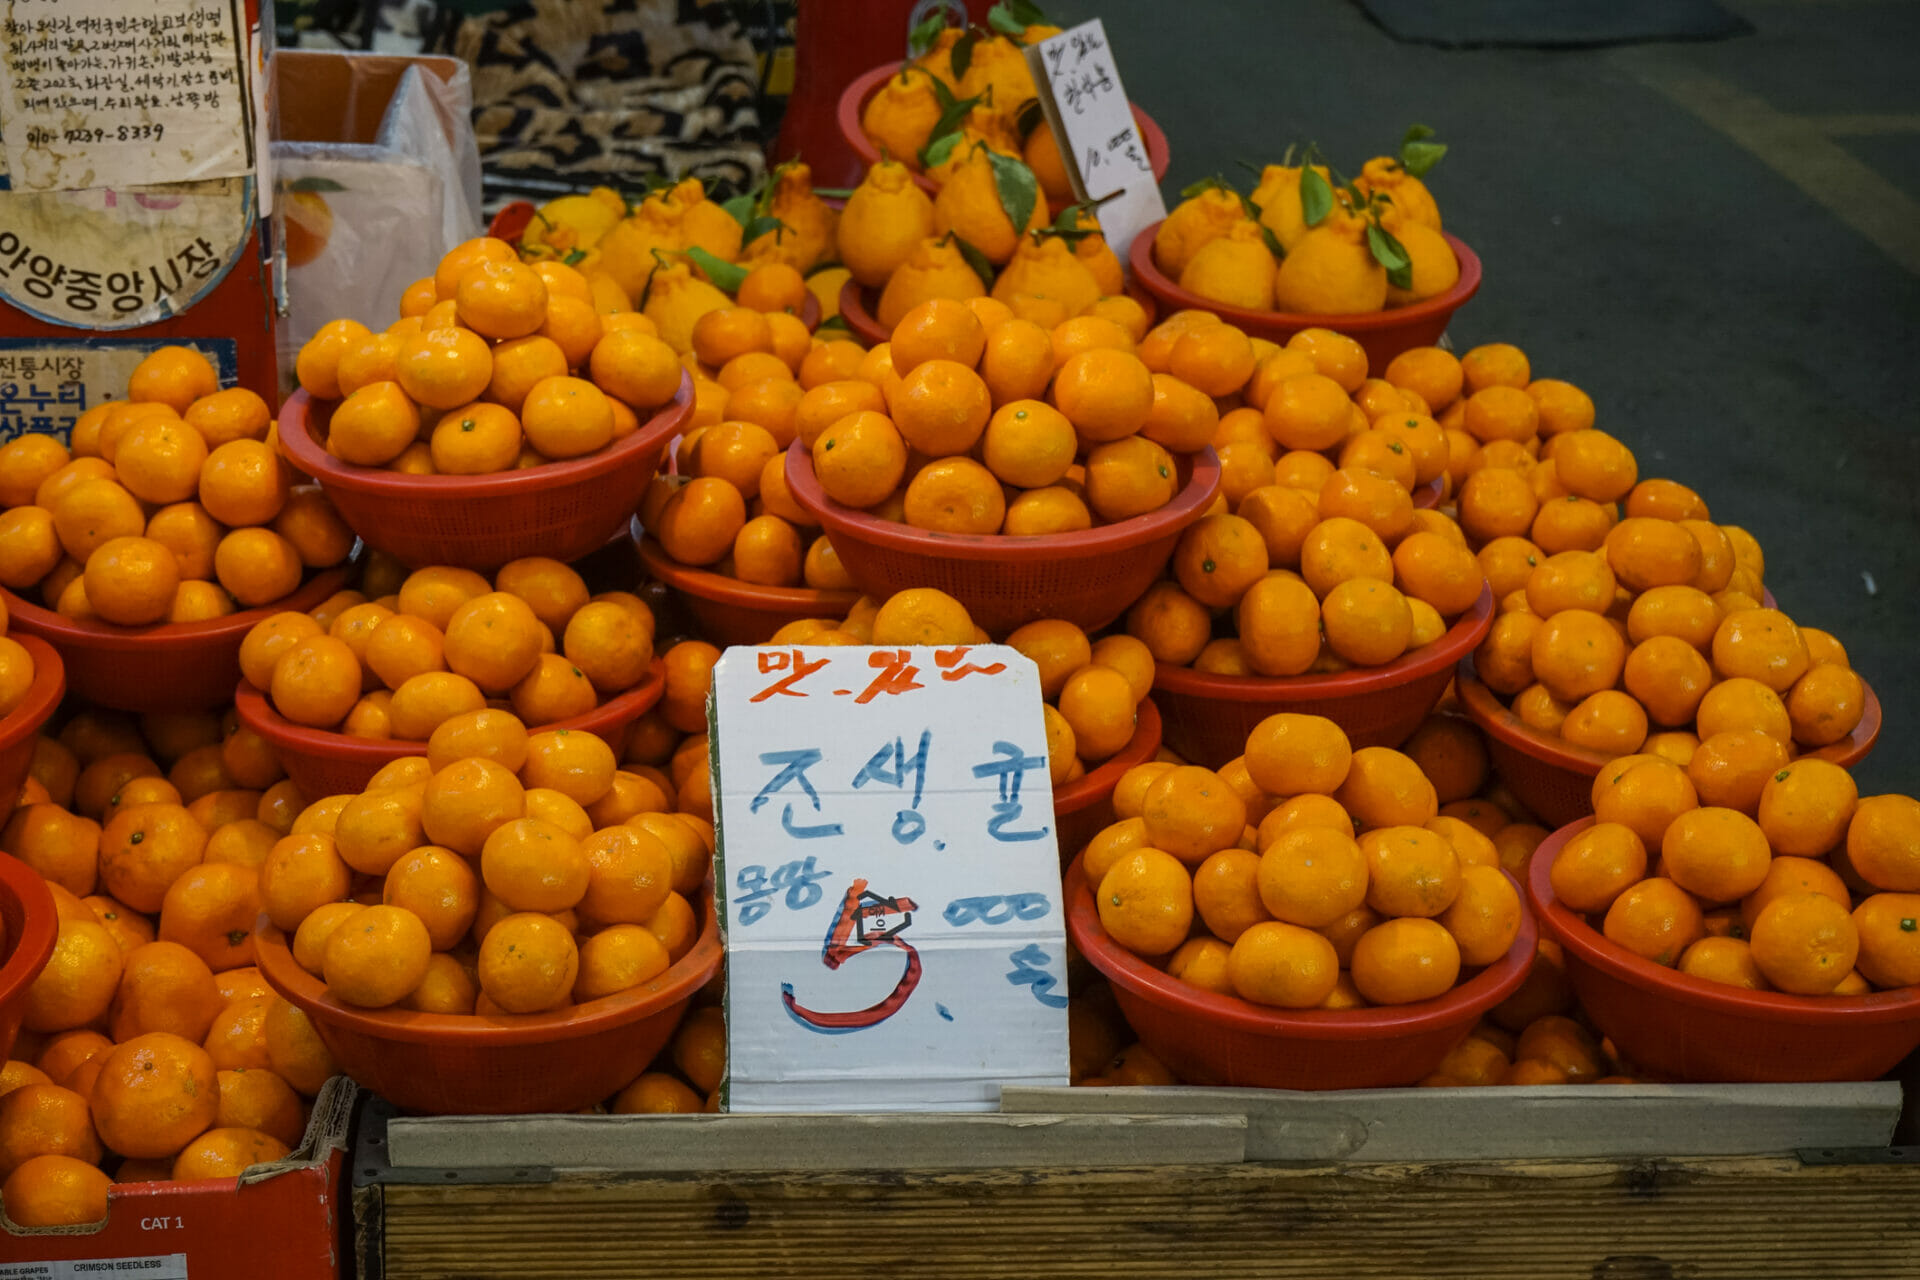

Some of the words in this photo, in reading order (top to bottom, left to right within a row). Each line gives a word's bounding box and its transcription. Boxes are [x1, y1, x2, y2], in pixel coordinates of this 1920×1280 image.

[0, 356, 85, 380] 전통시장
[0, 383, 86, 414] 온누리
[140, 1217, 171, 1231] CAT
[175, 1216, 184, 1229] 1
[20, 1267, 48, 1275] GRAPES
[73, 1263, 114, 1272] CRIMSON
[116, 1260, 162, 1270] SEEDLESS
